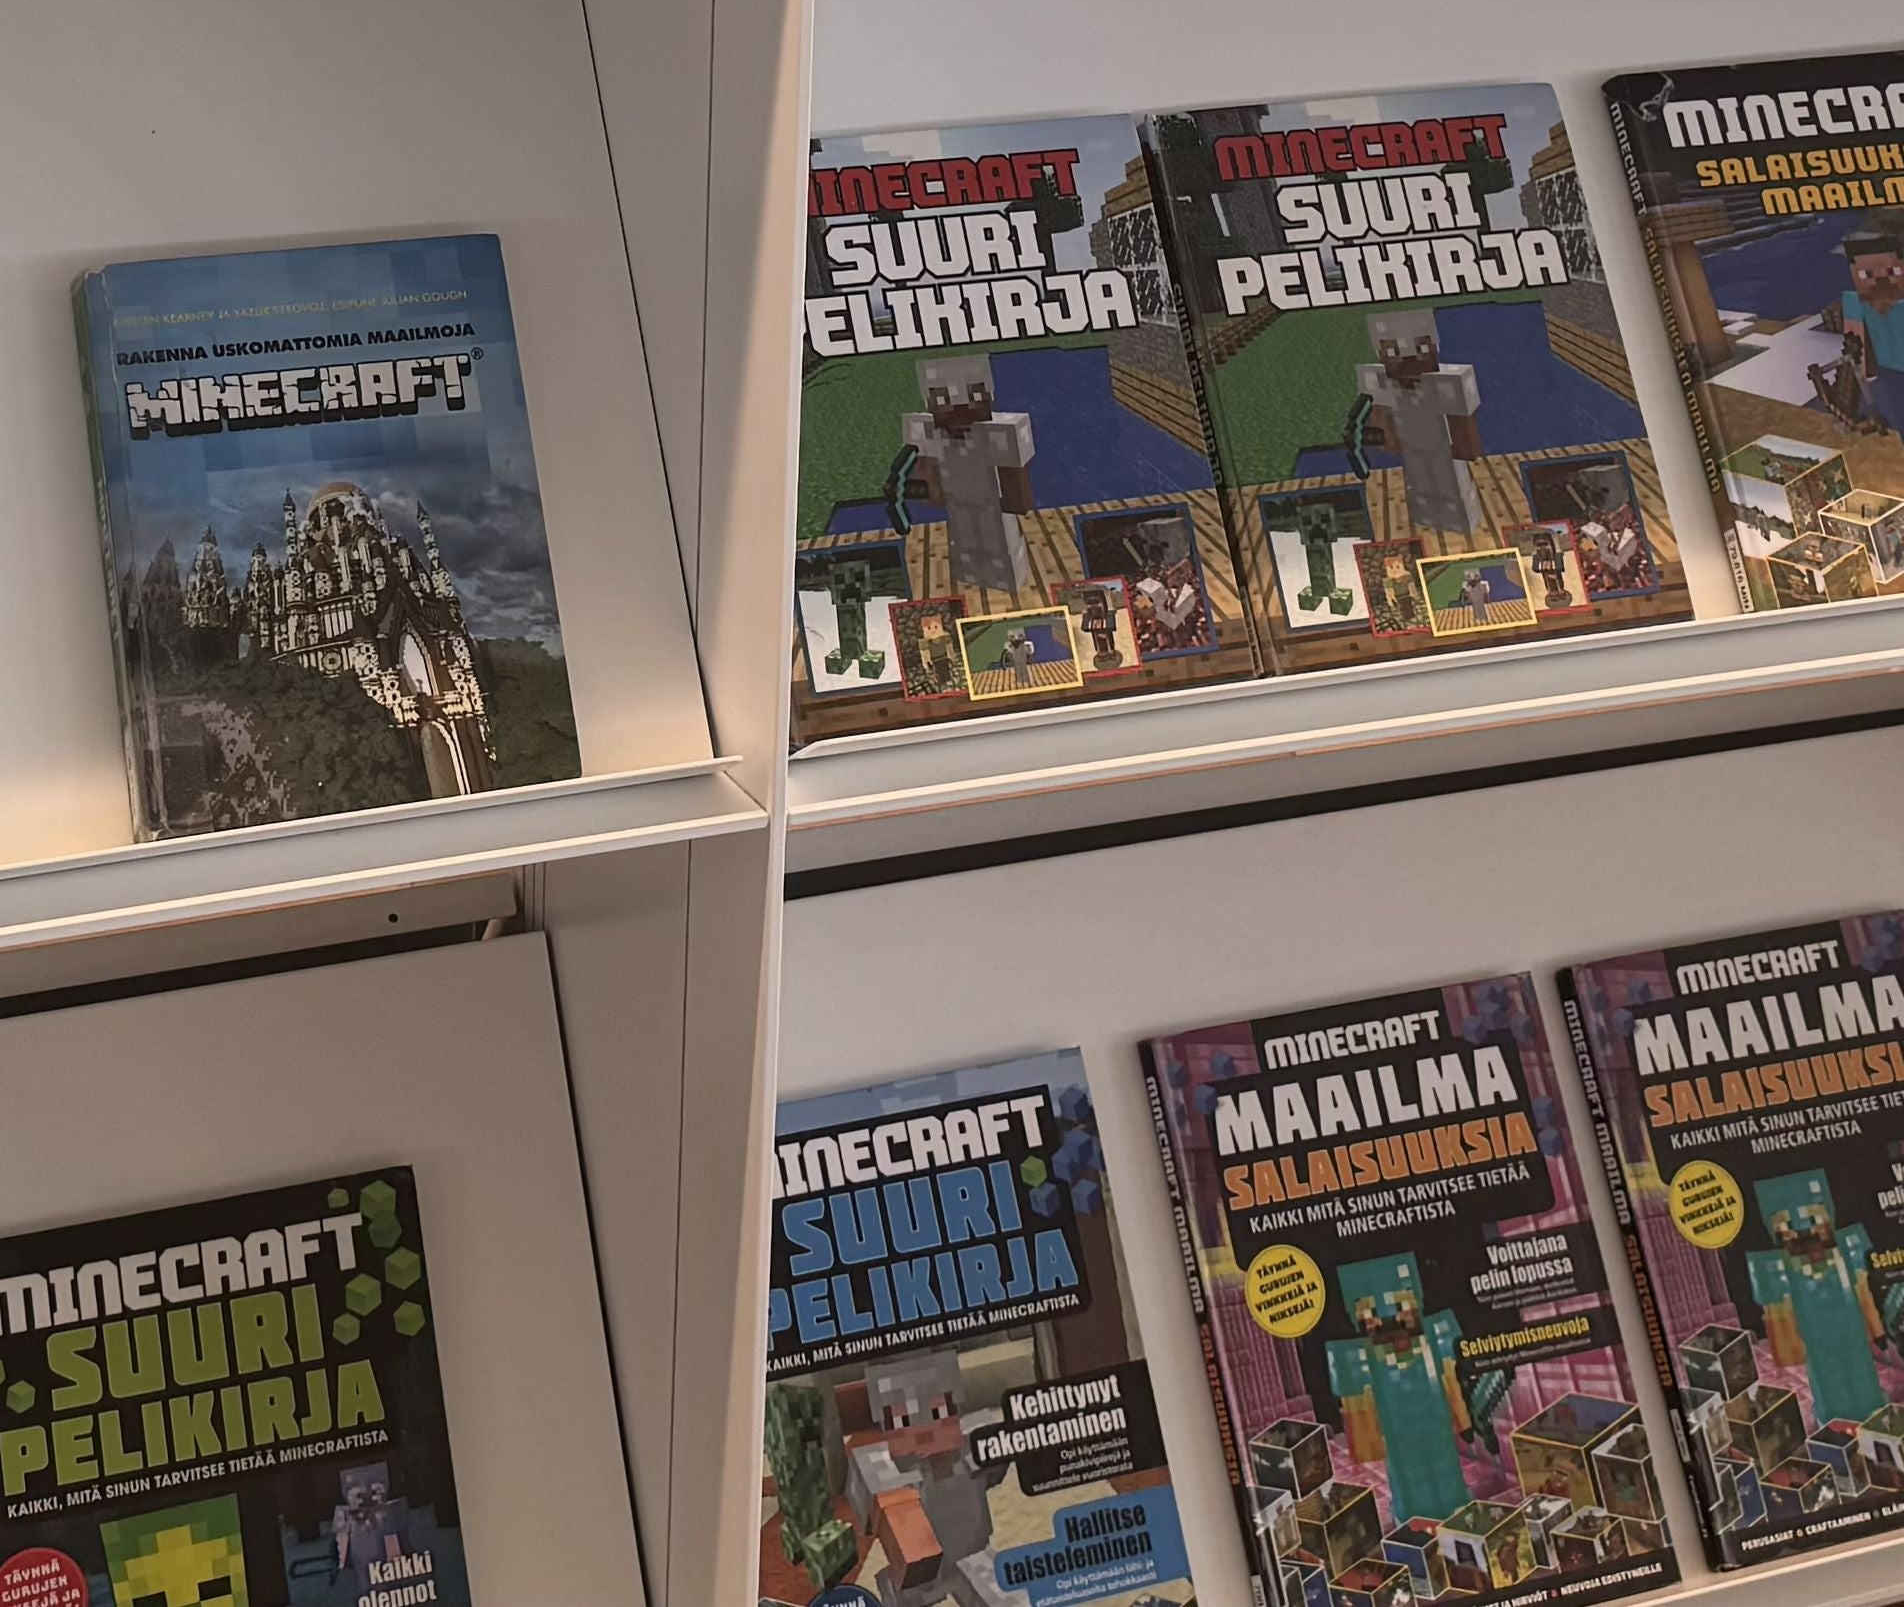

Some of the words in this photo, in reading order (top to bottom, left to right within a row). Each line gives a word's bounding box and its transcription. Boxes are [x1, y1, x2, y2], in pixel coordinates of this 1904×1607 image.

[1214, 113, 1507, 182] MINECRAFT
[1609, 101, 1647, 217] MINECRAFT
[1276, 172, 1482, 245] SUURI
[825, 210, 1046, 288] SUURI
[1217, 228, 1570, 317] PELIKIRJA
[116, 345, 208, 366] RAKENNA
[212, 329, 363, 359] USKOMATTOMIA
[367, 322, 475, 346] MAAILMOJA
[1676, 939, 1841, 995] MINECRAFT
[1264, 1009, 1441, 1070] MINECRAFT
[1564, 999, 1603, 1122] MINECRAFT
[1214, 1044, 1519, 1157] MAAILMA
[1669, 1124, 1722, 1151] KAIKKI
[1722, 1115, 1759, 1139] MITÄ
[1223, 1111, 1538, 1211] SALAISUUKSIA
[1249, 1207, 1305, 1235] KAIKKI
[1348, 1190, 1396, 1214] SINUN
[1479, 1161, 1531, 1189] TIETÄÄ
[782, 1160, 1023, 1277] SUURI
[45, 1283, 325, 1412] SUURI
[813, 1342, 843, 1363] MITÄ
[845, 1336, 883, 1357] SINUN
[0, 1359, 386, 1497] PELIKIRJA
[7, 1495, 64, 1519] KAIKKI,
[67, 1484, 103, 1507] MITÄ
[105, 1475, 151, 1500] SINUN
[153, 1462, 226, 1490] TARVITSEE
[229, 1450, 276, 1474] TIETÄÄ
[279, 1429, 389, 1463] MINECRAFTISTA
[1064, 1504, 1146, 1543] Hallitse
